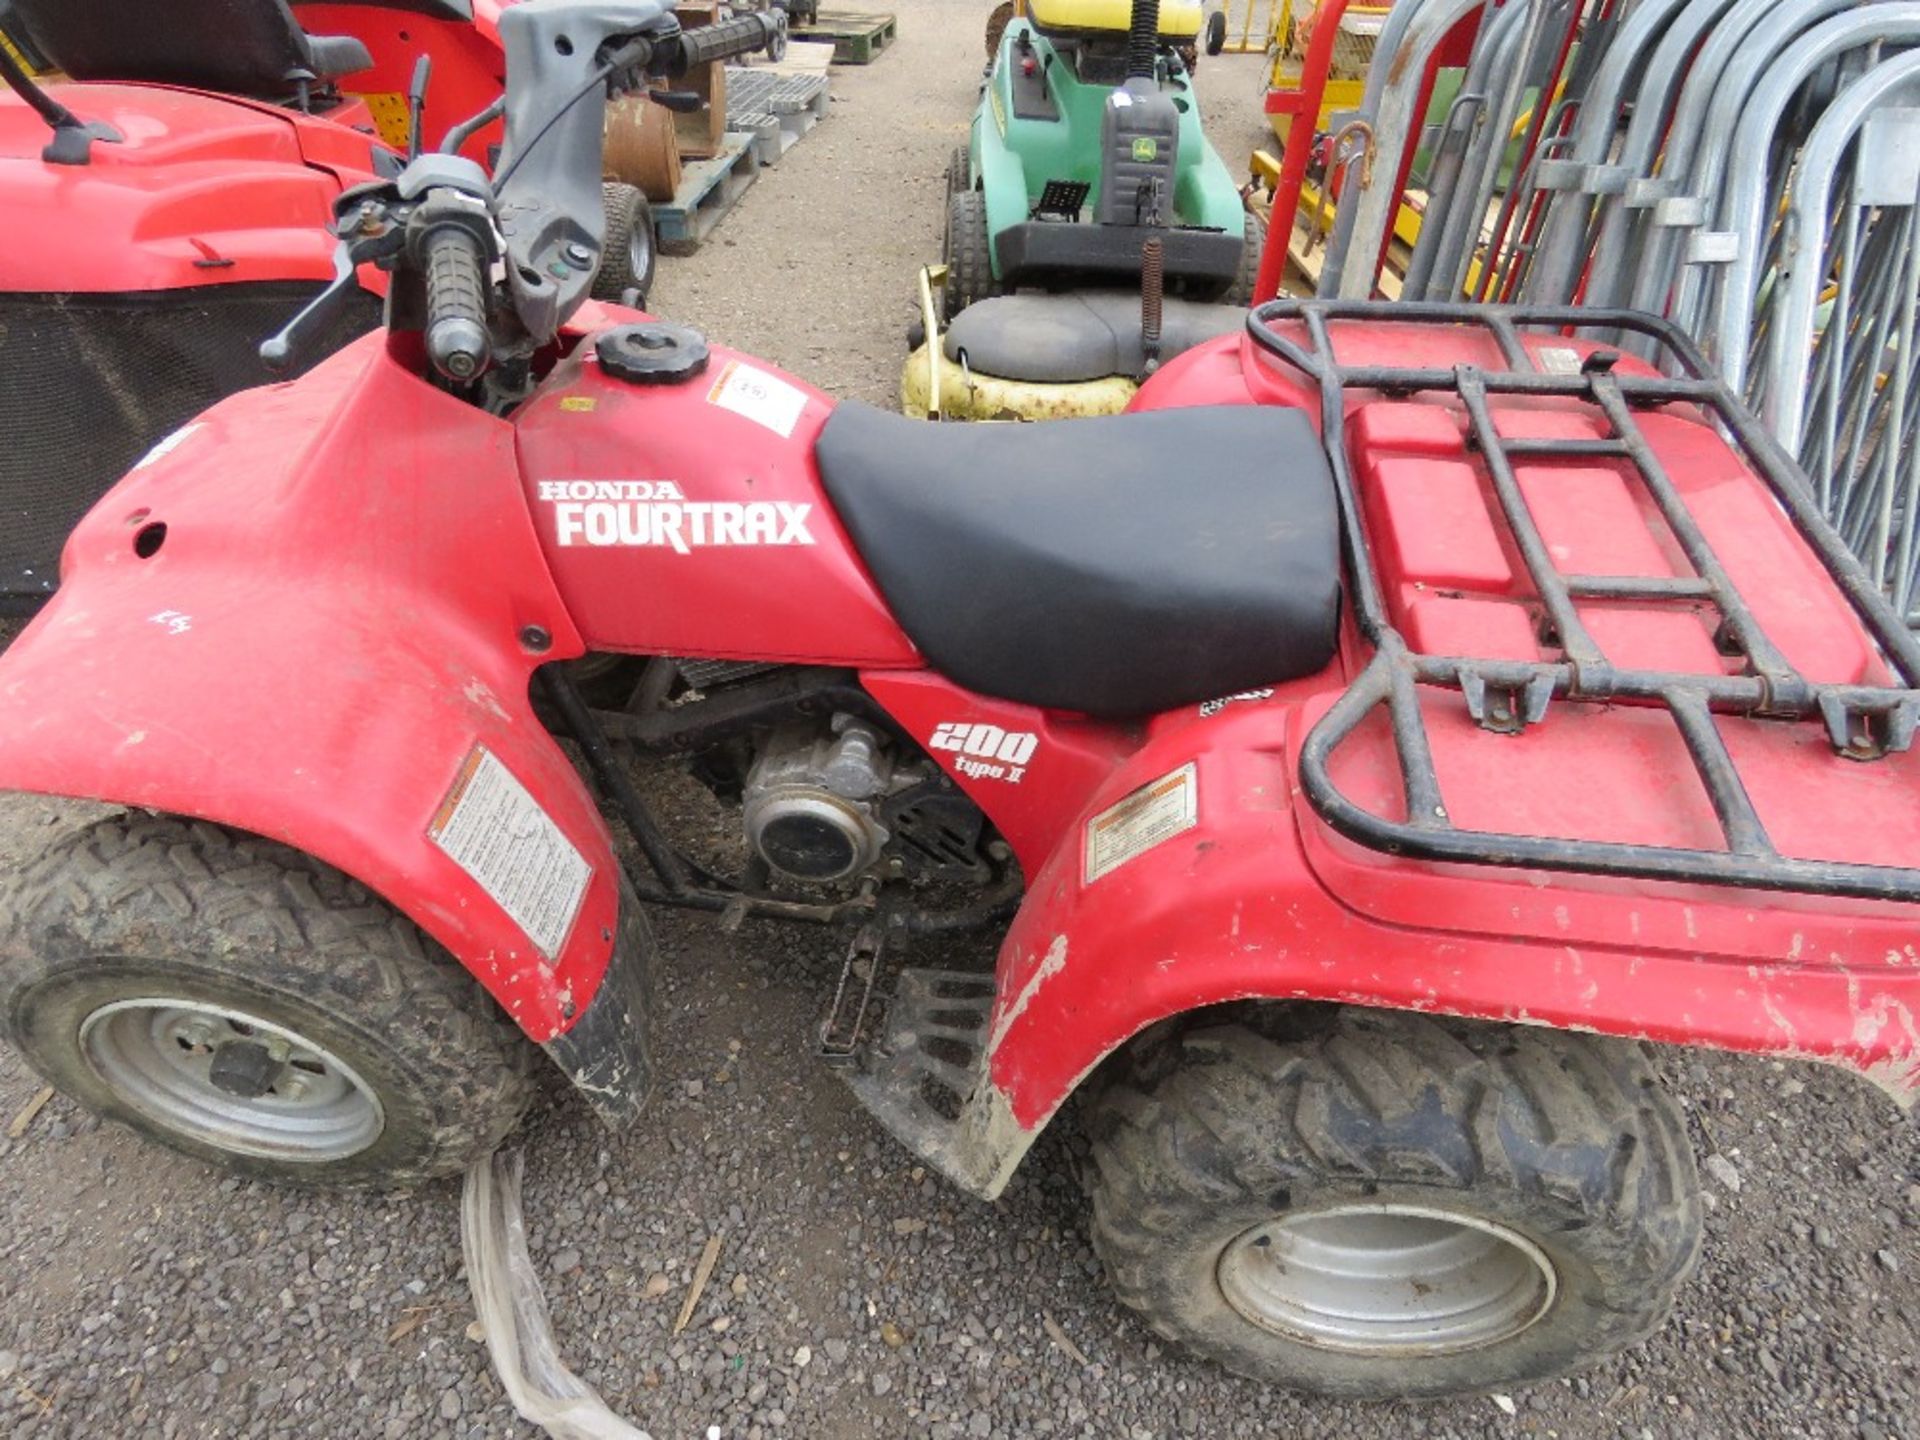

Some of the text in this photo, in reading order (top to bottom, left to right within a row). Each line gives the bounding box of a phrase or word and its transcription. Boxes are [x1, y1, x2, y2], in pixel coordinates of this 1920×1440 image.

[538, 480, 683, 500] HONDA
[556, 502, 815, 554] FOURTRAX
[929, 723, 1038, 765] 200
[954, 756, 1004, 780] type
